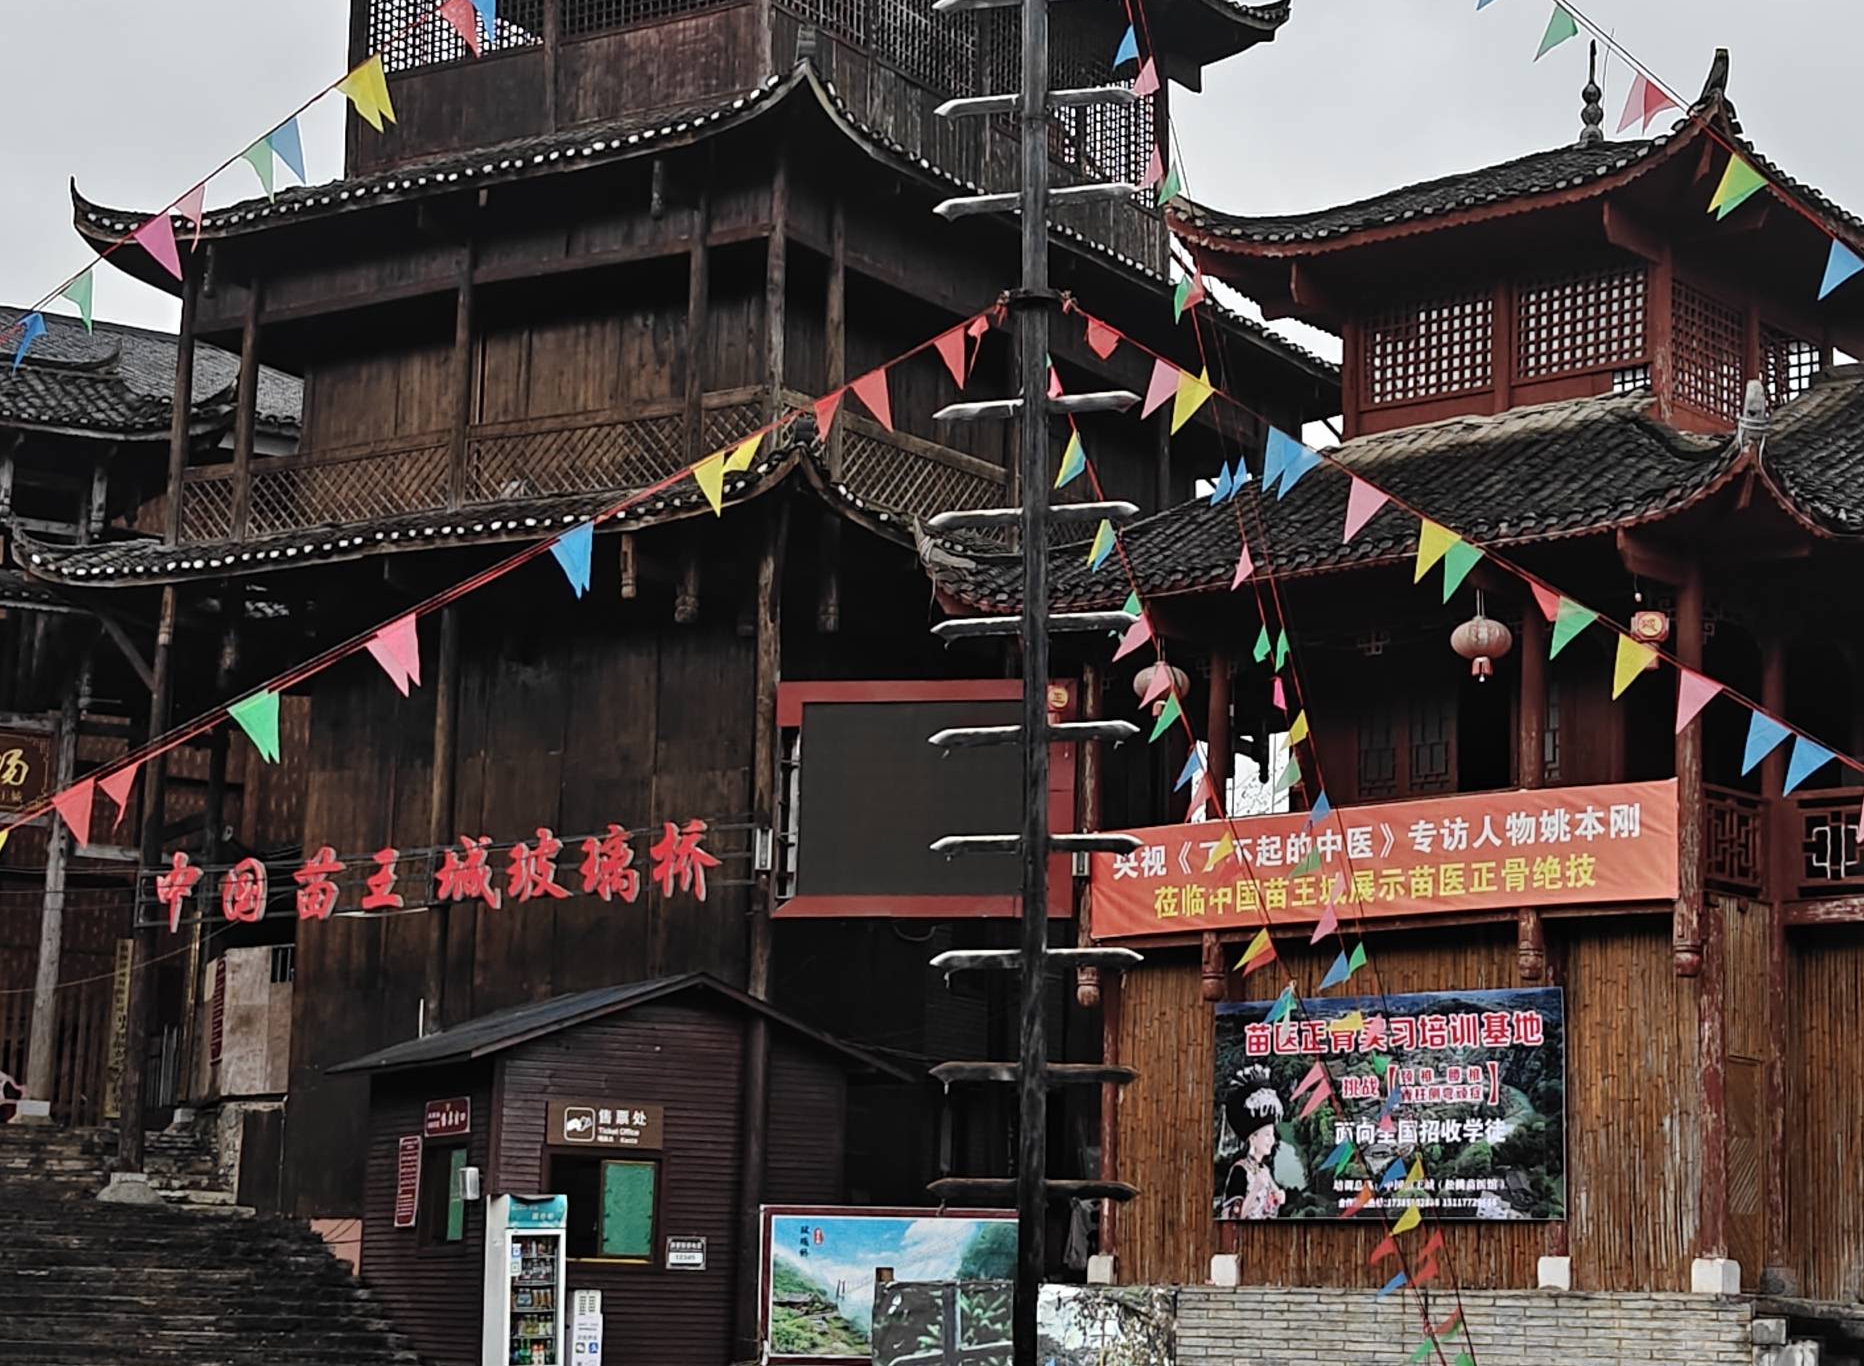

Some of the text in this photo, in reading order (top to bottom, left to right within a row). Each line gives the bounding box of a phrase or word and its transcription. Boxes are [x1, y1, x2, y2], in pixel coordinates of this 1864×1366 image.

[156, 819, 722, 933] 中国苗王城玻璃桥
